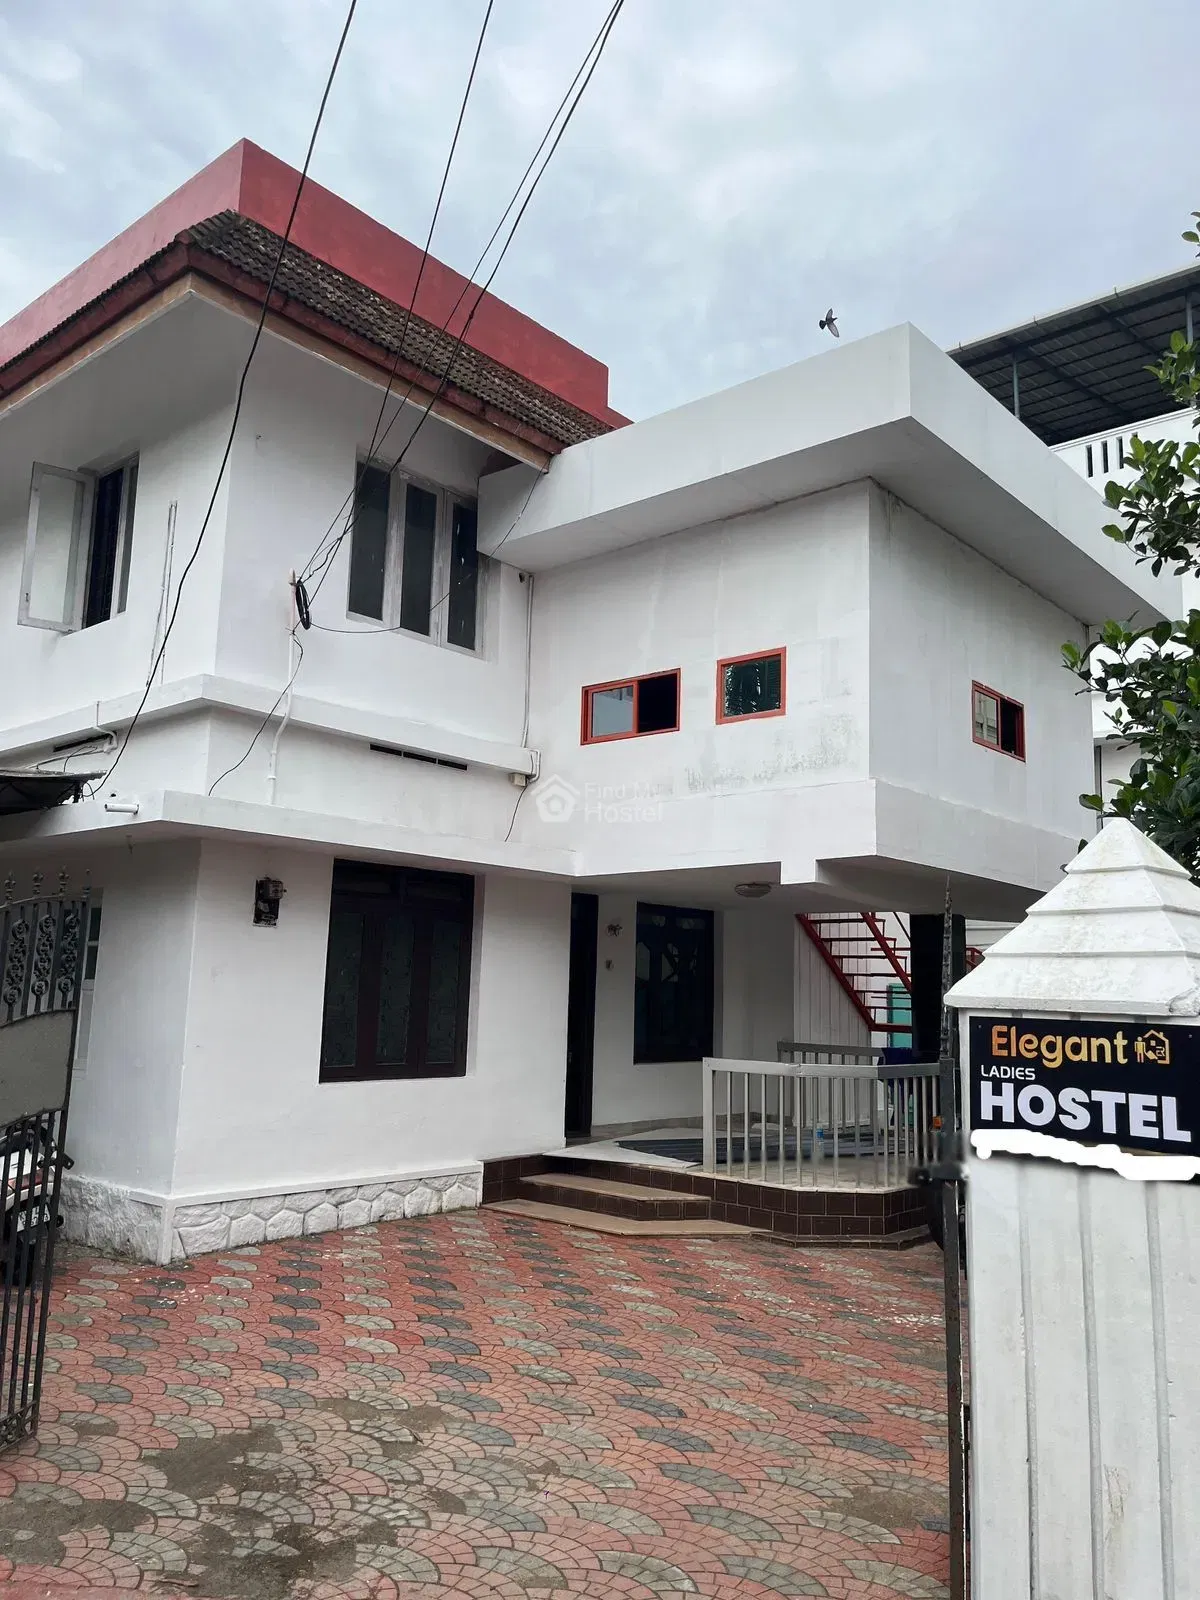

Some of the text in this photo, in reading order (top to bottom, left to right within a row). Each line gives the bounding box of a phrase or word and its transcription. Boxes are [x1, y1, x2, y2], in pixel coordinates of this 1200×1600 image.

[991, 1025, 1128, 1068] Elegant
[980, 1064, 1036, 1080] LADIES
[980, 1080, 1192, 1143] HOSTEL
